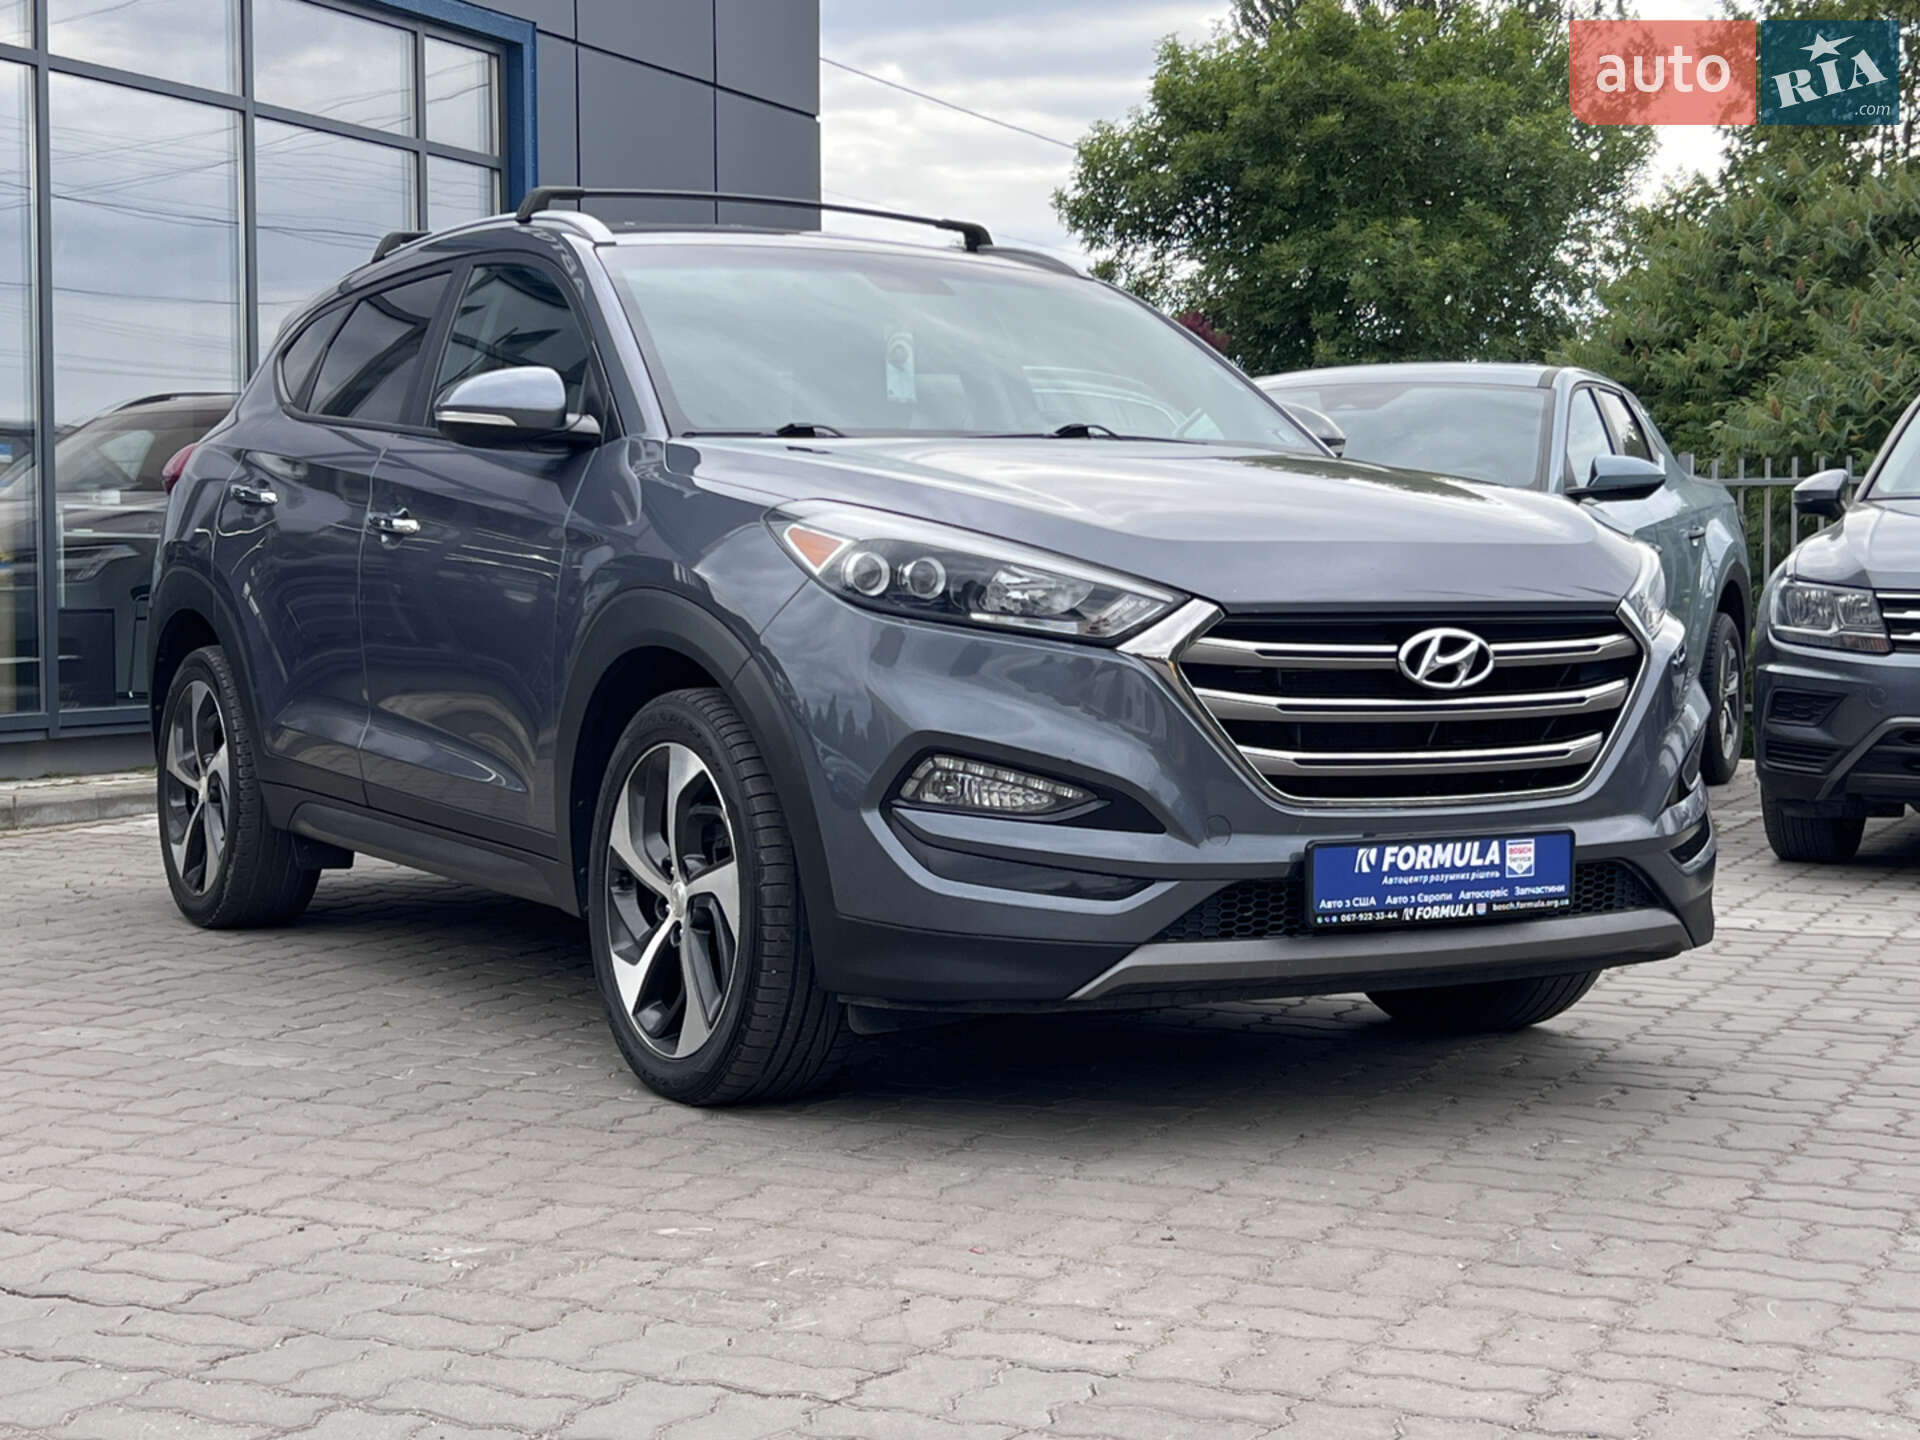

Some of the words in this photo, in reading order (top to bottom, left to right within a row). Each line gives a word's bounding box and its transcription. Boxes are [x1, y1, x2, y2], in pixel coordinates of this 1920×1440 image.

[1381, 841, 1500, 872] FORMULA
[1458, 886, 1509, 901] Автосервіс
[1514, 884, 1565, 896] Запчастини
[1319, 899, 1343, 909] Авто
[1352, 896, 1376, 907] США
[1385, 895, 1408, 905] Авто
[1415, 903, 1474, 920] FORMULA
